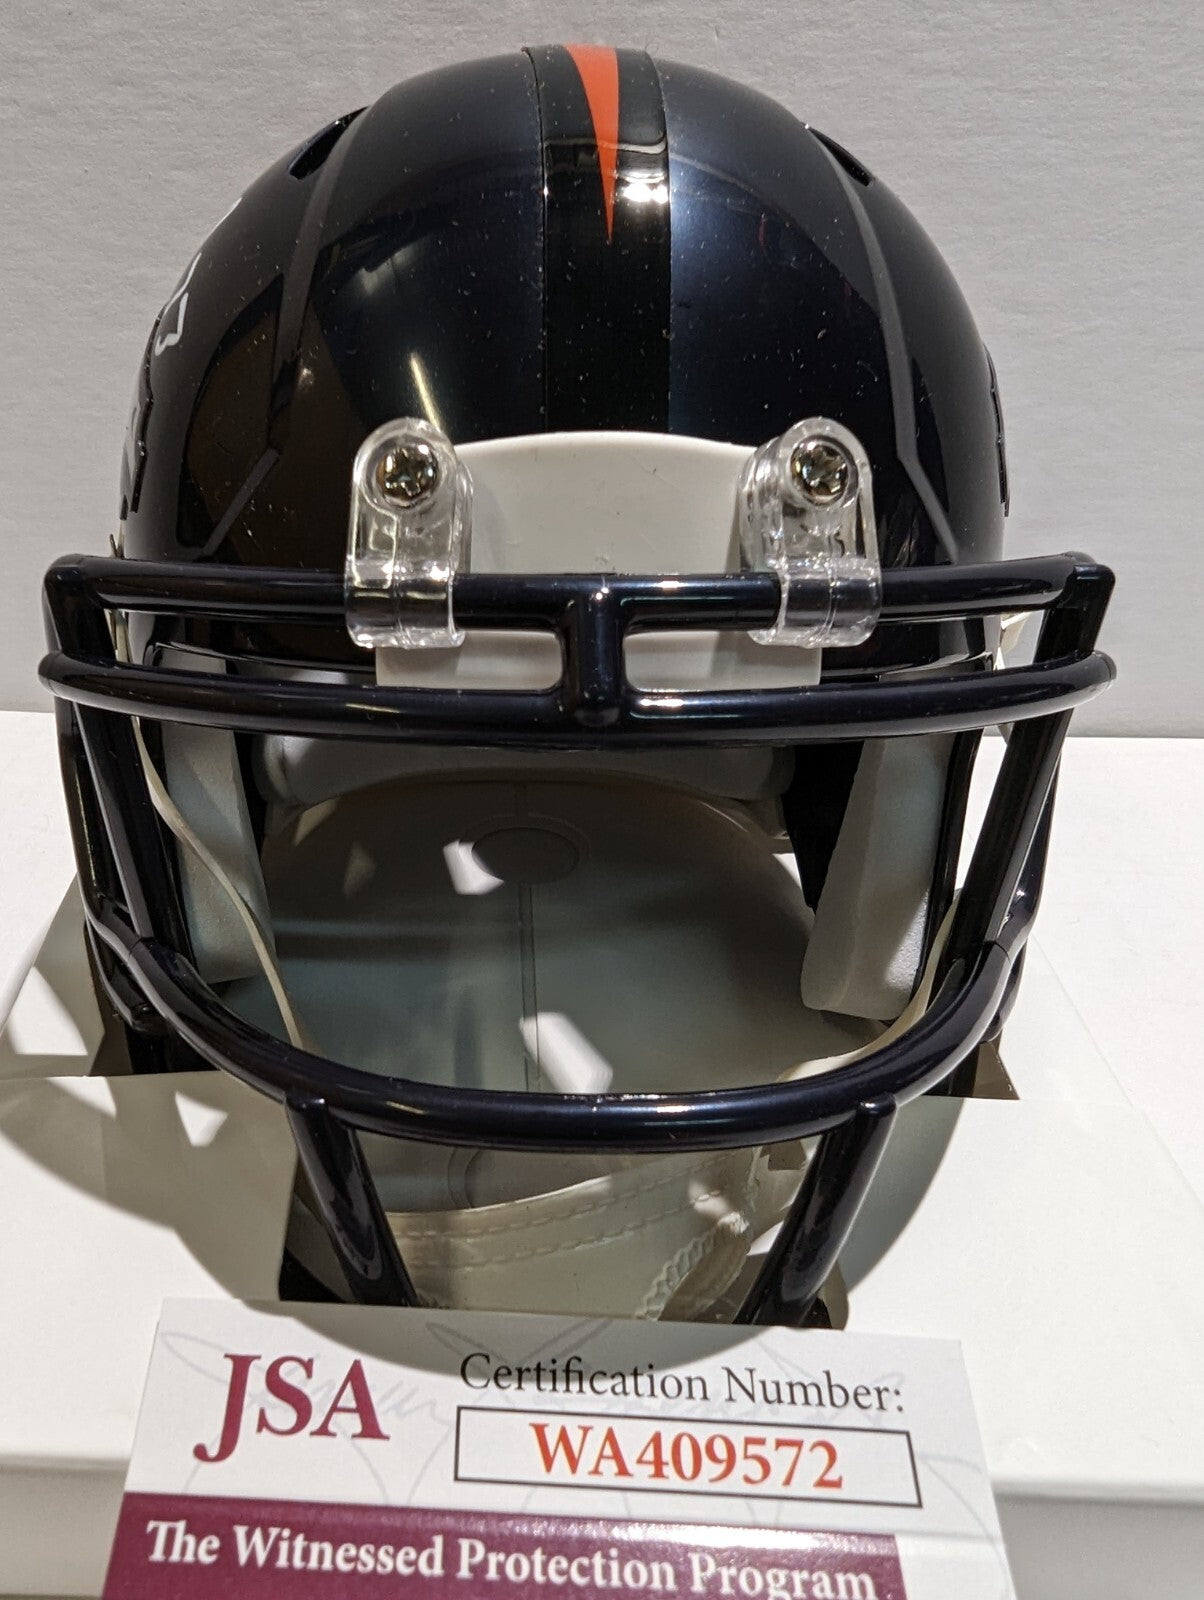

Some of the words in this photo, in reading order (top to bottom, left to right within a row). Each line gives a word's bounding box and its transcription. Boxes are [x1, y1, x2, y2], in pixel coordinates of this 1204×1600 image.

[194, 1354, 390, 1463] JSA
[460, 1352, 710, 1401] Certification
[723, 1366, 905, 1412] Number:
[529, 1423, 844, 1489] WA409572
[146, 1520, 219, 1564] The
[232, 1525, 444, 1577] Witnessed
[457, 1540, 678, 1590] Protection
[689, 1553, 877, 1600] Program
